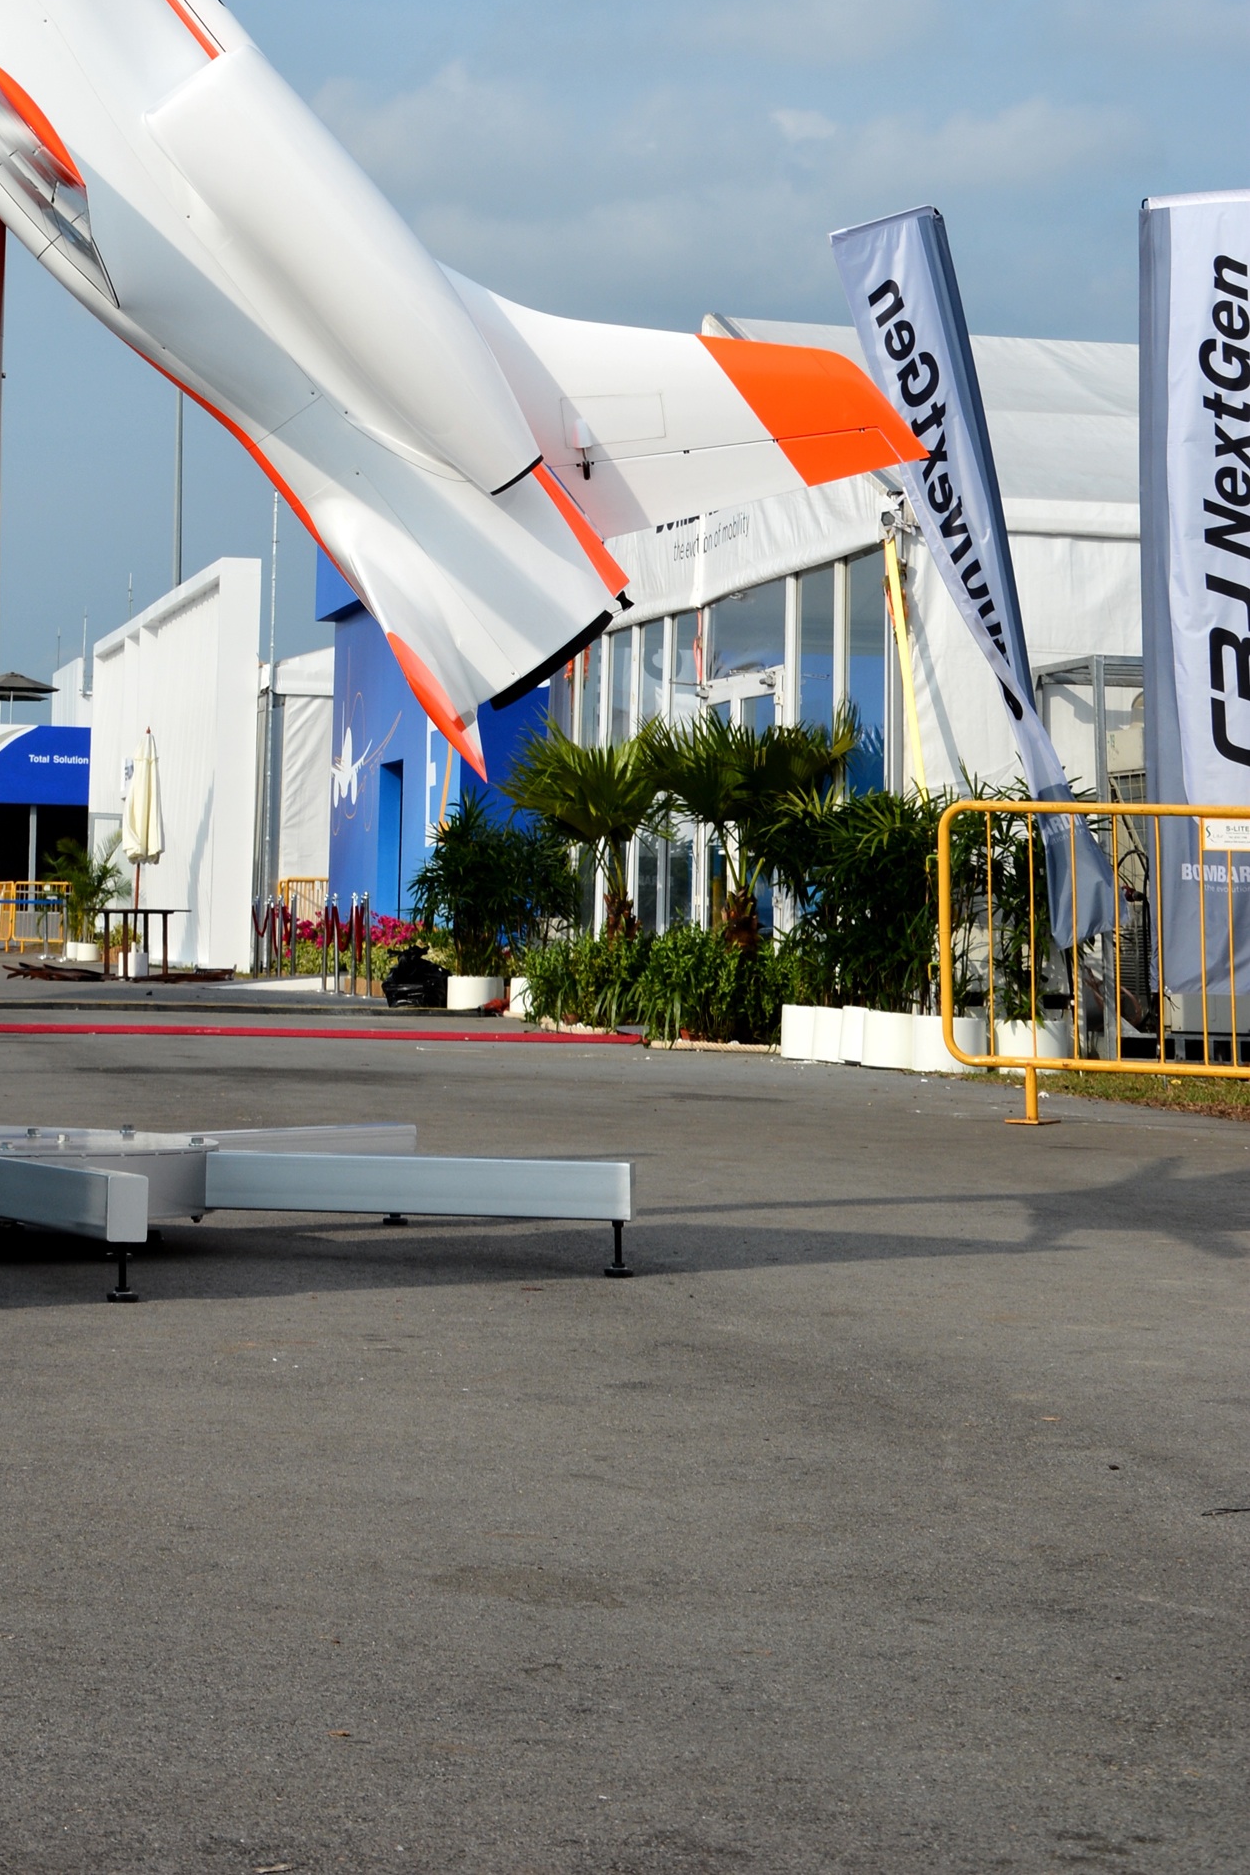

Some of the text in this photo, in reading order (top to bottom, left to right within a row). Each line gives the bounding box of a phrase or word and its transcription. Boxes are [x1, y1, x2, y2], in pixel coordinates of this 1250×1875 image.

[1198, 253, 1250, 561] NextGen
[28, 754, 89, 764] Total Solution
